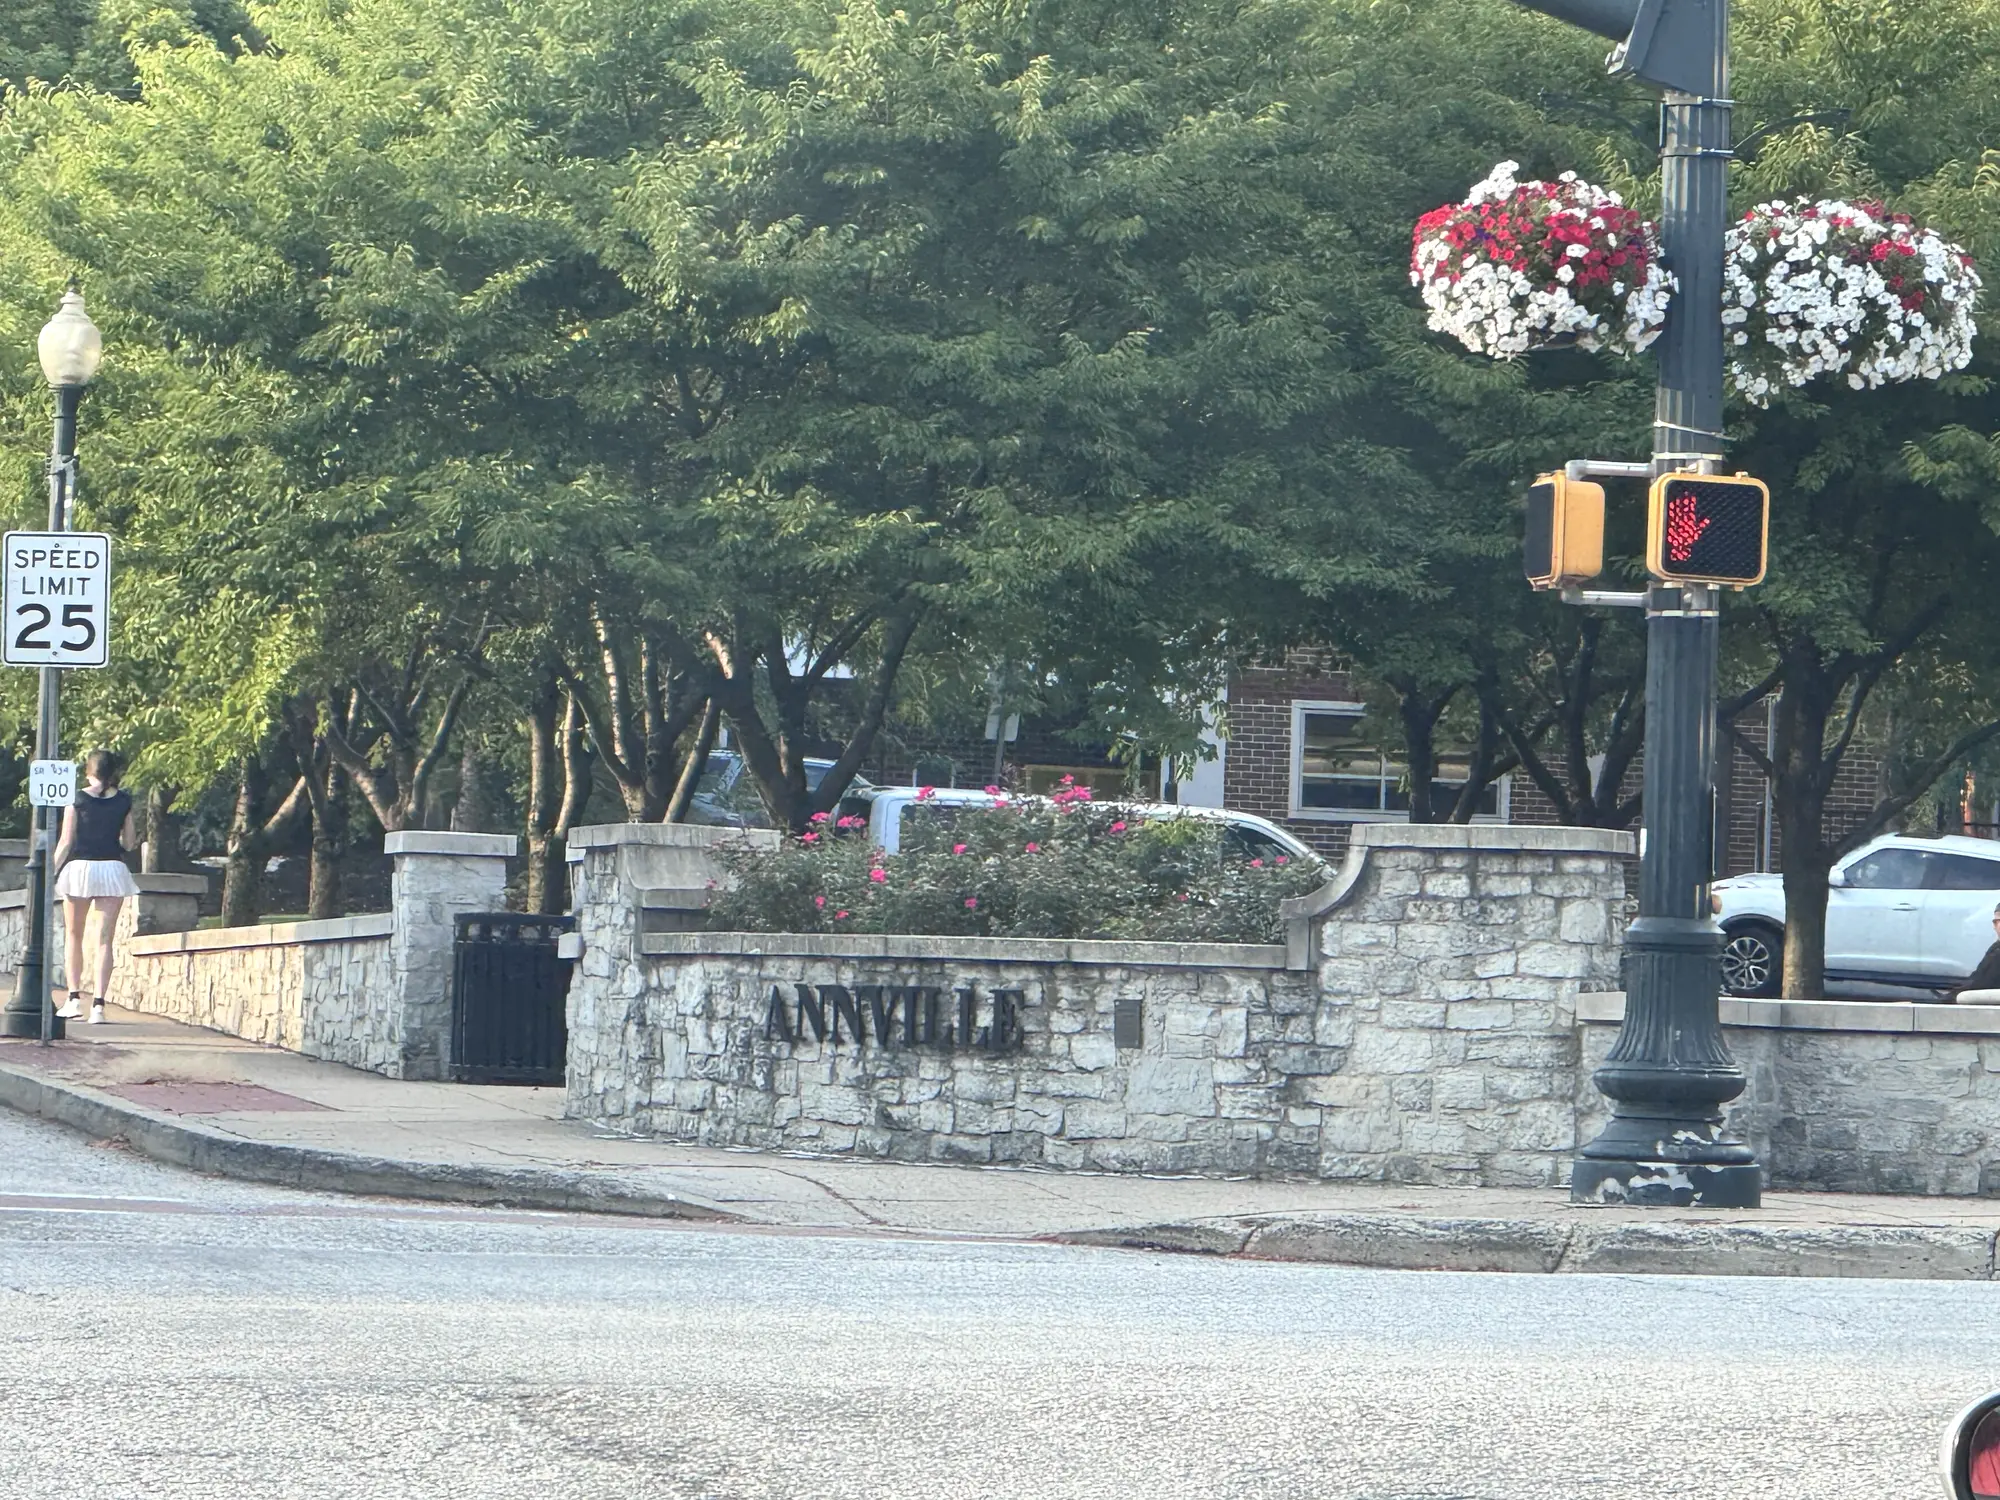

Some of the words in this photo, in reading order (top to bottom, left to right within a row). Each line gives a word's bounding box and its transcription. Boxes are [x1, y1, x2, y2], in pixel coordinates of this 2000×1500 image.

[14, 549, 100, 569] SPEED
[22, 576, 91, 596] LIMIT
[15, 603, 96, 651] 25
[39, 783, 69, 798] 100
[764, 984, 1024, 1050] ANNVILLE
